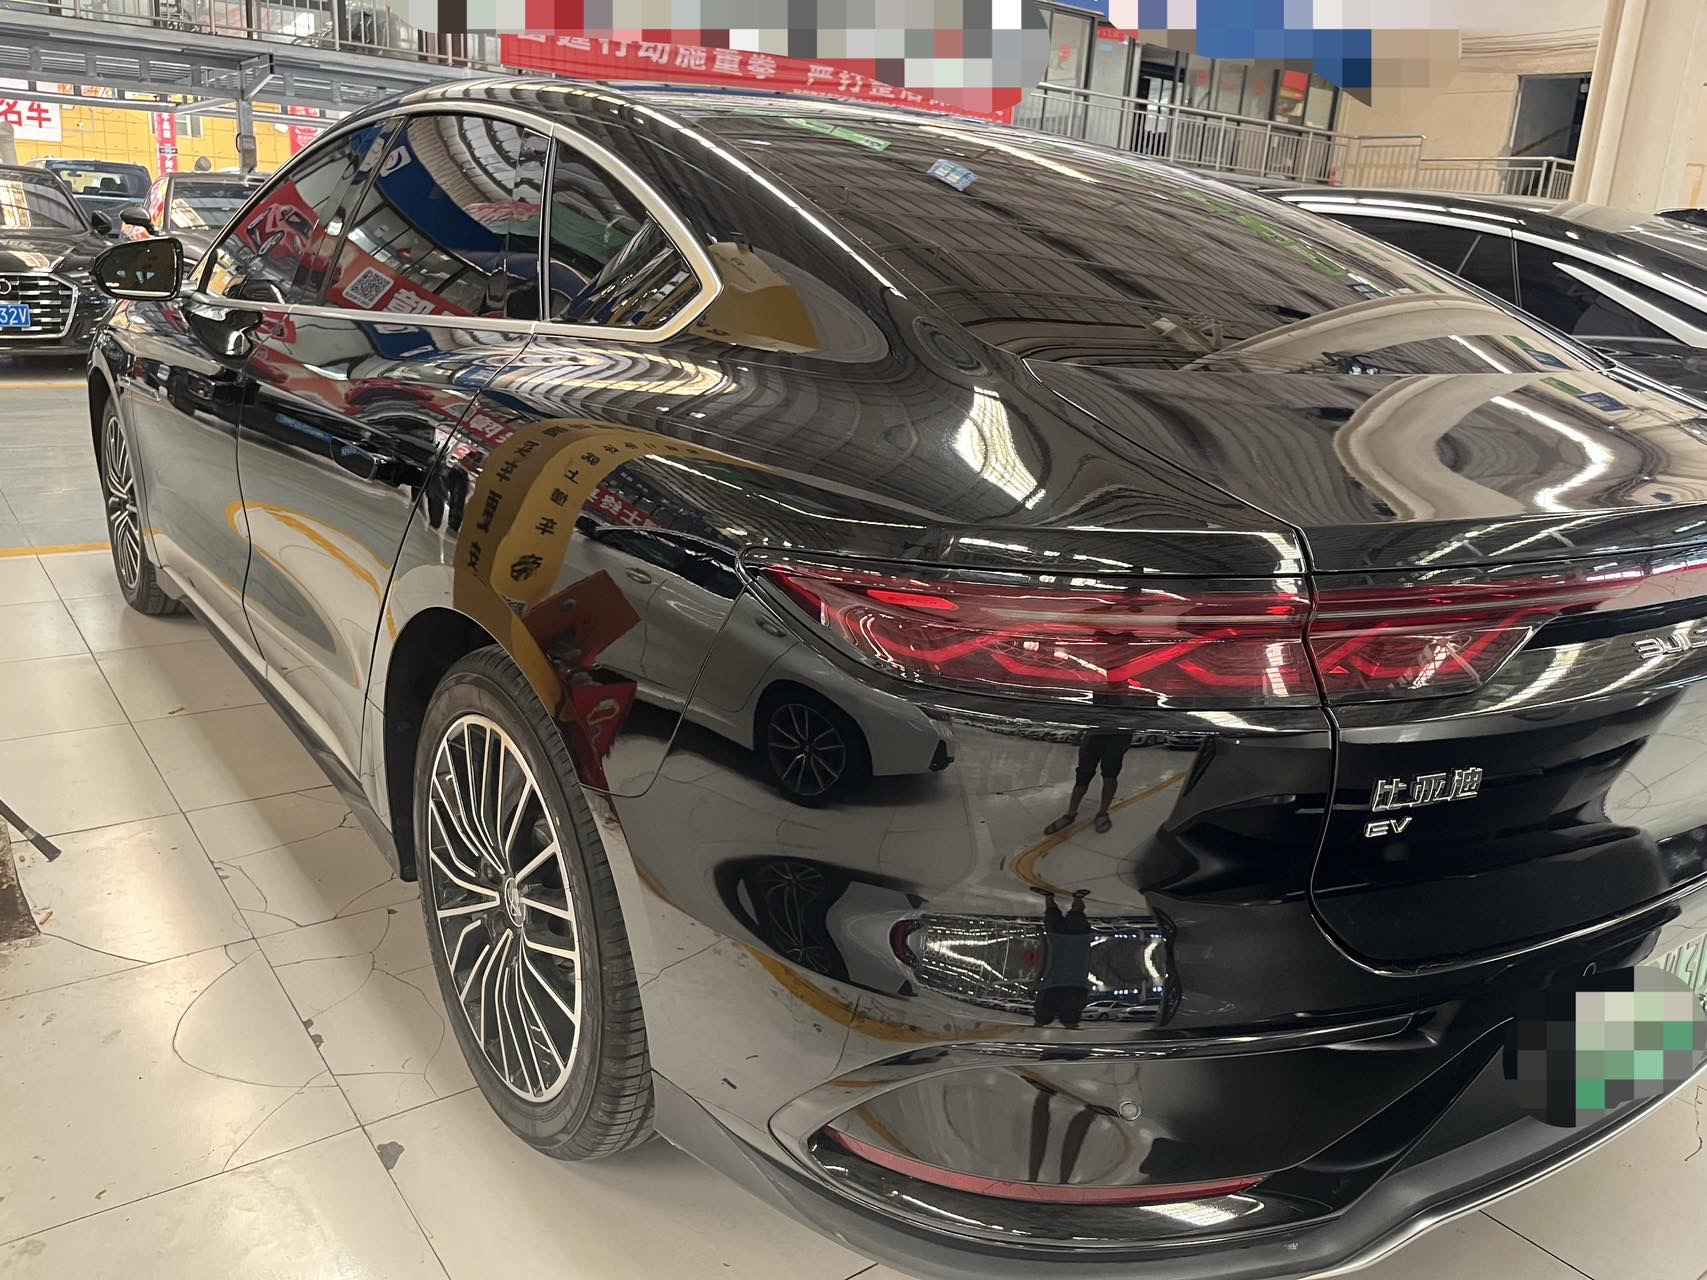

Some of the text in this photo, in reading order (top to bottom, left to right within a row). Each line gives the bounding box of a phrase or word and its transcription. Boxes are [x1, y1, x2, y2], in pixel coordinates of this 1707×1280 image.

[517, 33, 776, 80] 行动施重拳
[1372, 767, 1483, 812] 比亚迪
[1365, 817, 1412, 838] EV
